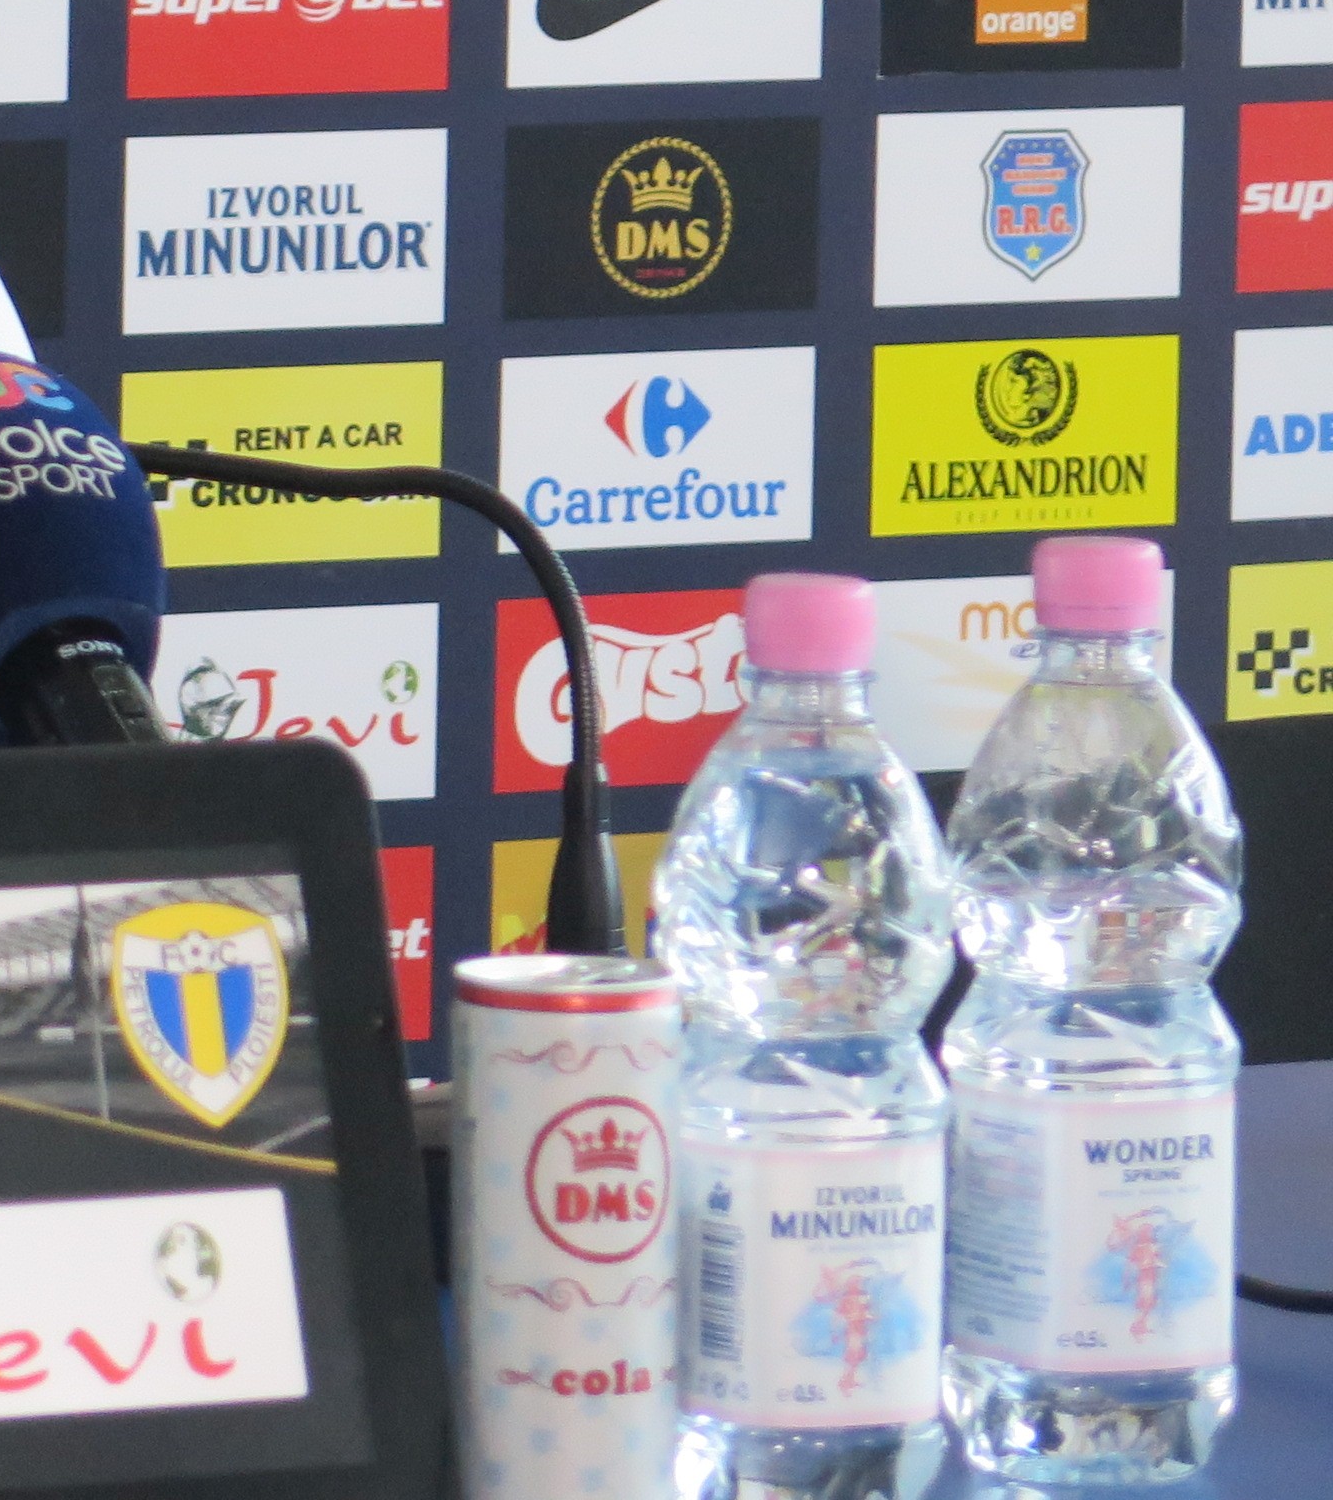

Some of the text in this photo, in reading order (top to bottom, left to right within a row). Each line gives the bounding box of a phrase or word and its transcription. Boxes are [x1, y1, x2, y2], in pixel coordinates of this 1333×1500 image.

[981, 11, 1075, 39] orange
[208, 184, 363, 219] IZVORUL
[137, 222, 427, 277] MINUNILOR
[617, 219, 709, 260] DMS
[235, 423, 402, 451] RENT A CAR
[901, 455, 1146, 503] ALEXANDRION
[523, 473, 786, 532] Carrefour
[1081, 1133, 1216, 1166] WONDER
[555, 1180, 656, 1225] DMS
[769, 1202, 938, 1241] MINUNILOR
[550, 1359, 652, 1397] cola
